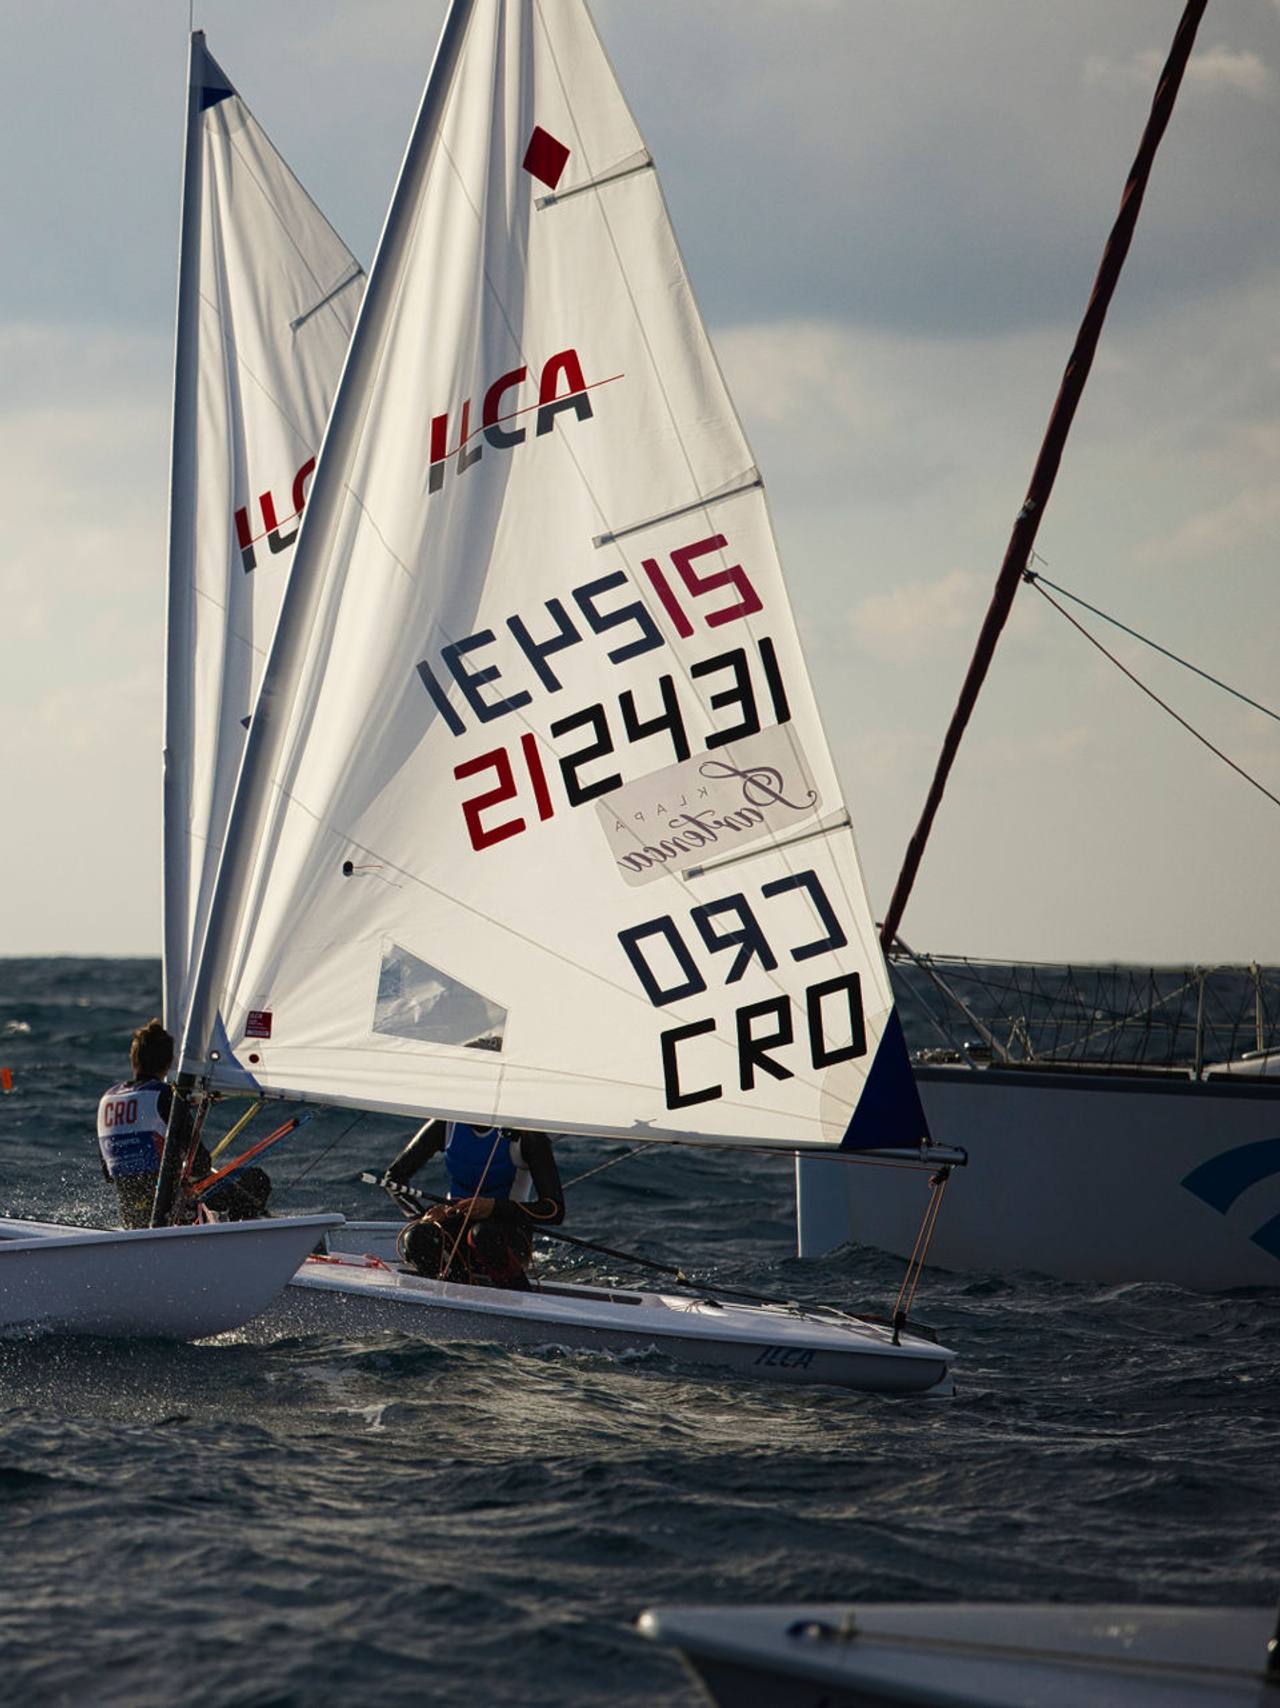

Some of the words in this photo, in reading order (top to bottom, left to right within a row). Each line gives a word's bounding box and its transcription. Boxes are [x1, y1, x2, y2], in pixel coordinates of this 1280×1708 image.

[427, 348, 594, 494] ILCA
[234, 455, 316, 573] ILC
[453, 636, 792, 852] 212431
[660, 972, 868, 1110] CRO
[105, 1099, 137, 1127] CRO
[754, 1345, 816, 1369] ILCA
